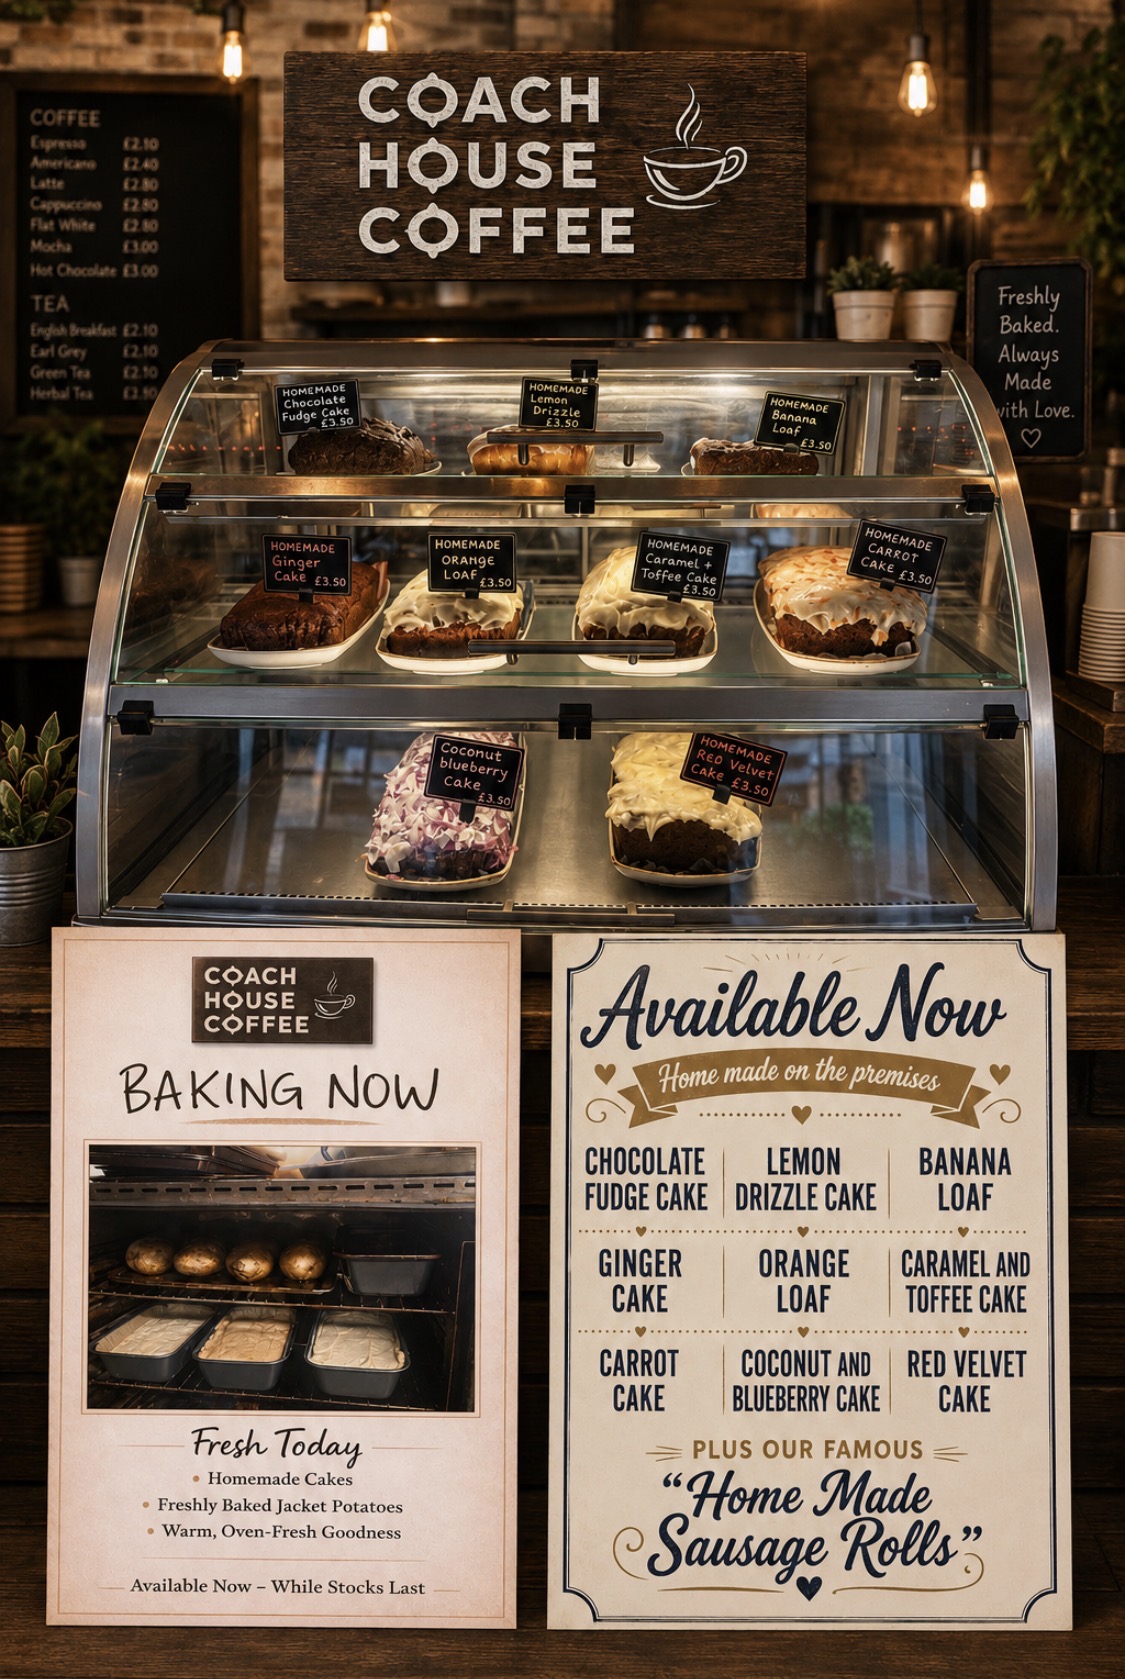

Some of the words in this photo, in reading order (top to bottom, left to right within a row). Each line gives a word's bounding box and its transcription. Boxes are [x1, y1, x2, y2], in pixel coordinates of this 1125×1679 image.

[358, 72, 600, 128] COACH
[30, 108, 101, 127] COFFEE
[30, 135, 87, 152] Espresso
[30, 156, 97, 170] Americano
[358, 137, 597, 194] HOUSE
[30, 176, 65, 190] Latte
[30, 195, 103, 214] Cappuccino
[30, 217, 54, 232] Flat
[58, 217, 96, 232] White
[358, 202, 635, 259] COFFEE
[30, 238, 72, 253] Mocha
[30, 262, 54, 277] Hot
[57, 262, 117, 277] Chocolate
[30, 294, 70, 312] TEA
[998, 285, 1060, 312] Freshly
[30, 322, 67, 340] English
[69, 322, 117, 337] Breakfast
[122, 323, 159, 338] £2.10
[1000, 314, 1059, 334] Baked.
[30, 343, 55, 358] Earl
[57, 343, 87, 361] Grey
[122, 343, 159, 358] £2.10
[998, 344, 1059, 370] Always
[30, 365, 67, 379] Green
[69, 364, 91, 379] Tea
[282, 384, 346, 396] HOMEMADE
[529, 382, 588, 395] HOMEMADE
[1004, 372, 1052, 391] Made
[30, 385, 69, 400] Herbal
[71, 385, 94, 400] Tea
[284, 396, 346, 408] Chocolate
[530, 394, 568, 404] Lemon
[534, 406, 580, 418] Drizzle
[770, 397, 830, 413] HOMEMADE
[1035, 400, 1075, 418] Love.
[282, 410, 317, 424] Fudge
[322, 407, 350, 418] Cake
[321, 417, 354, 428] £3.50
[546, 418, 579, 428] £3.50
[772, 410, 817, 426] Banana
[772, 422, 802, 437] Loaf
[800, 438, 832, 450] £3.50
[270, 541, 335, 554] HOMEMADE
[435, 539, 500, 550] HOMEMADE
[648, 538, 714, 556] HOMEMADE
[865, 527, 933, 551] HOMEMADE
[646, 553, 700, 569] Caramel
[704, 561, 712, 570] +
[868, 542, 919, 563] CARROT
[272, 555, 320, 572] Ginger
[274, 571, 307, 582] Cake
[314, 576, 346, 586] £3.50
[444, 570, 478, 580] LOAF
[480, 578, 512, 588] £3.50
[641, 568, 682, 584] Toffee
[686, 572, 717, 584] Cake
[898, 570, 932, 584] £3.50
[682, 584, 716, 596] £3.50
[440, 742, 502, 762] Coconut
[700, 735, 772, 764] HOMEMADE
[440, 757, 508, 782] blueberry
[730, 759, 774, 780] Velvet
[444, 776, 481, 791] Cake
[731, 778, 768, 796] £3.50
[478, 792, 511, 806] £3.50
[204, 965, 296, 986] COACH
[204, 990, 295, 1011] HOUSE
[580, 964, 861, 1050] Available
[865, 962, 1008, 1042] Now
[204, 1014, 309, 1035] COFFEE
[658, 1062, 719, 1094] Home
[724, 1059, 778, 1086] made
[784, 1064, 810, 1080] on
[814, 1056, 848, 1082] the
[849, 1065, 942, 1093] premises
[119, 1063, 303, 1114] BAKING
[328, 1064, 439, 1112] NOW
[585, 1147, 706, 1175] CHOCOLATE
[767, 1147, 841, 1175] LEMON
[919, 1147, 1012, 1176] BANANA
[585, 1182, 650, 1211] FUDGE
[656, 1182, 708, 1211] CAKE
[735, 1182, 818, 1211] DRIZZLE
[824, 1182, 877, 1211] CAKE
[938, 1182, 994, 1212] LOAF
[598, 1249, 682, 1278] GINGER
[758, 1249, 850, 1278] ORANGE
[901, 1250, 990, 1278] CARAMEL
[996, 1251, 1030, 1278] AND
[612, 1284, 668, 1312] CAKE
[777, 1284, 832, 1312] LOAF
[906, 1285, 973, 1313] TOFFEE
[979, 1285, 1027, 1313] CAKE
[599, 1349, 680, 1377] CARROT
[741, 1350, 832, 1377] COCONUT
[838, 1352, 871, 1377] AND
[908, 1350, 946, 1378] RED
[953, 1350, 1027, 1378] VELVET
[613, 1384, 666, 1412] CAKE
[732, 1385, 830, 1412] BLUEBERRY
[836, 1385, 880, 1412] CAKE
[938, 1384, 991, 1412] CAKE
[191, 1426, 268, 1459] Fresh
[274, 1428, 363, 1469] Today
[692, 1440, 752, 1460] PLUS
[762, 1440, 813, 1460] OUR
[824, 1440, 923, 1460] FAMOUS
[208, 1472, 300, 1486] Homemade
[304, 1472, 353, 1486] Cakes
[662, 1470, 804, 1521] “Home
[812, 1468, 933, 1517] Made
[157, 1498, 218, 1516] Freshly
[222, 1498, 272, 1512] Baked
[276, 1499, 327, 1515] Jacket
[332, 1500, 403, 1514] Potatoes
[162, 1524, 217, 1540] Warm,
[222, 1524, 317, 1539] Oven-Fresh
[322, 1525, 402, 1540] Goodness
[647, 1512, 830, 1585] Sausage
[840, 1516, 982, 1578] Rolls”
[130, 1578, 208, 1594] Available
[213, 1580, 252, 1594] Now
[271, 1580, 323, 1594] While
[328, 1580, 384, 1595] Stocks
[389, 1580, 426, 1595] Last
